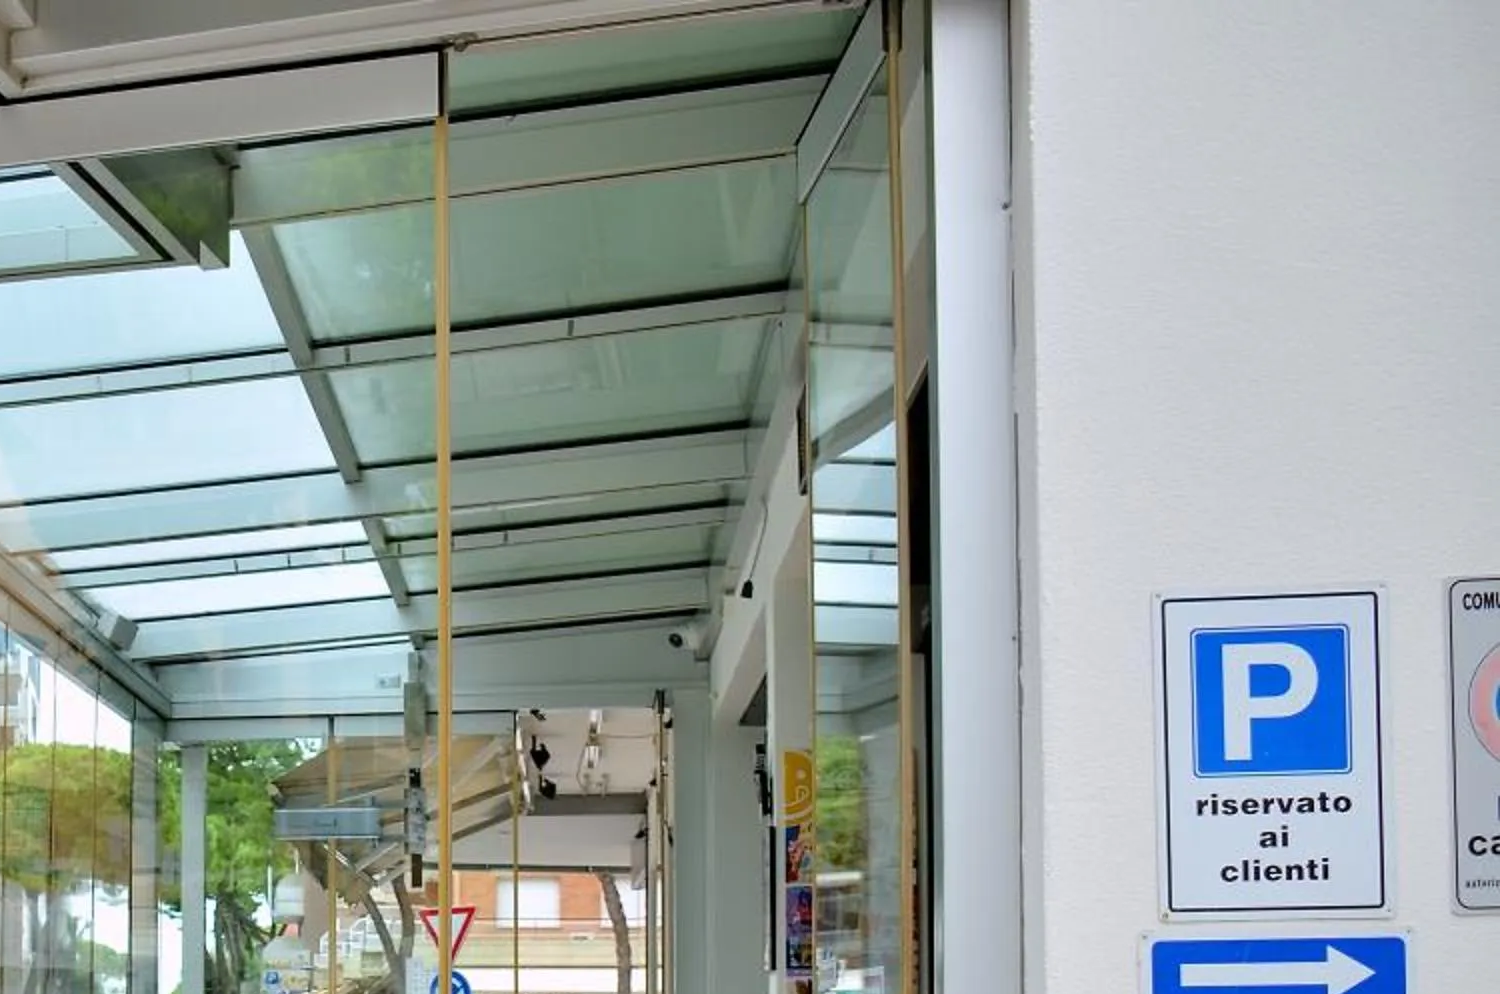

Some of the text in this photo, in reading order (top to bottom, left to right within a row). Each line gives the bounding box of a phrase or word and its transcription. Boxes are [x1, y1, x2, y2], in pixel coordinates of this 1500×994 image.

[1221, 641, 1319, 761] P
[1196, 792, 1352, 816] riservato
[1259, 825, 1290, 848] ai
[1220, 858, 1330, 882] clienti
